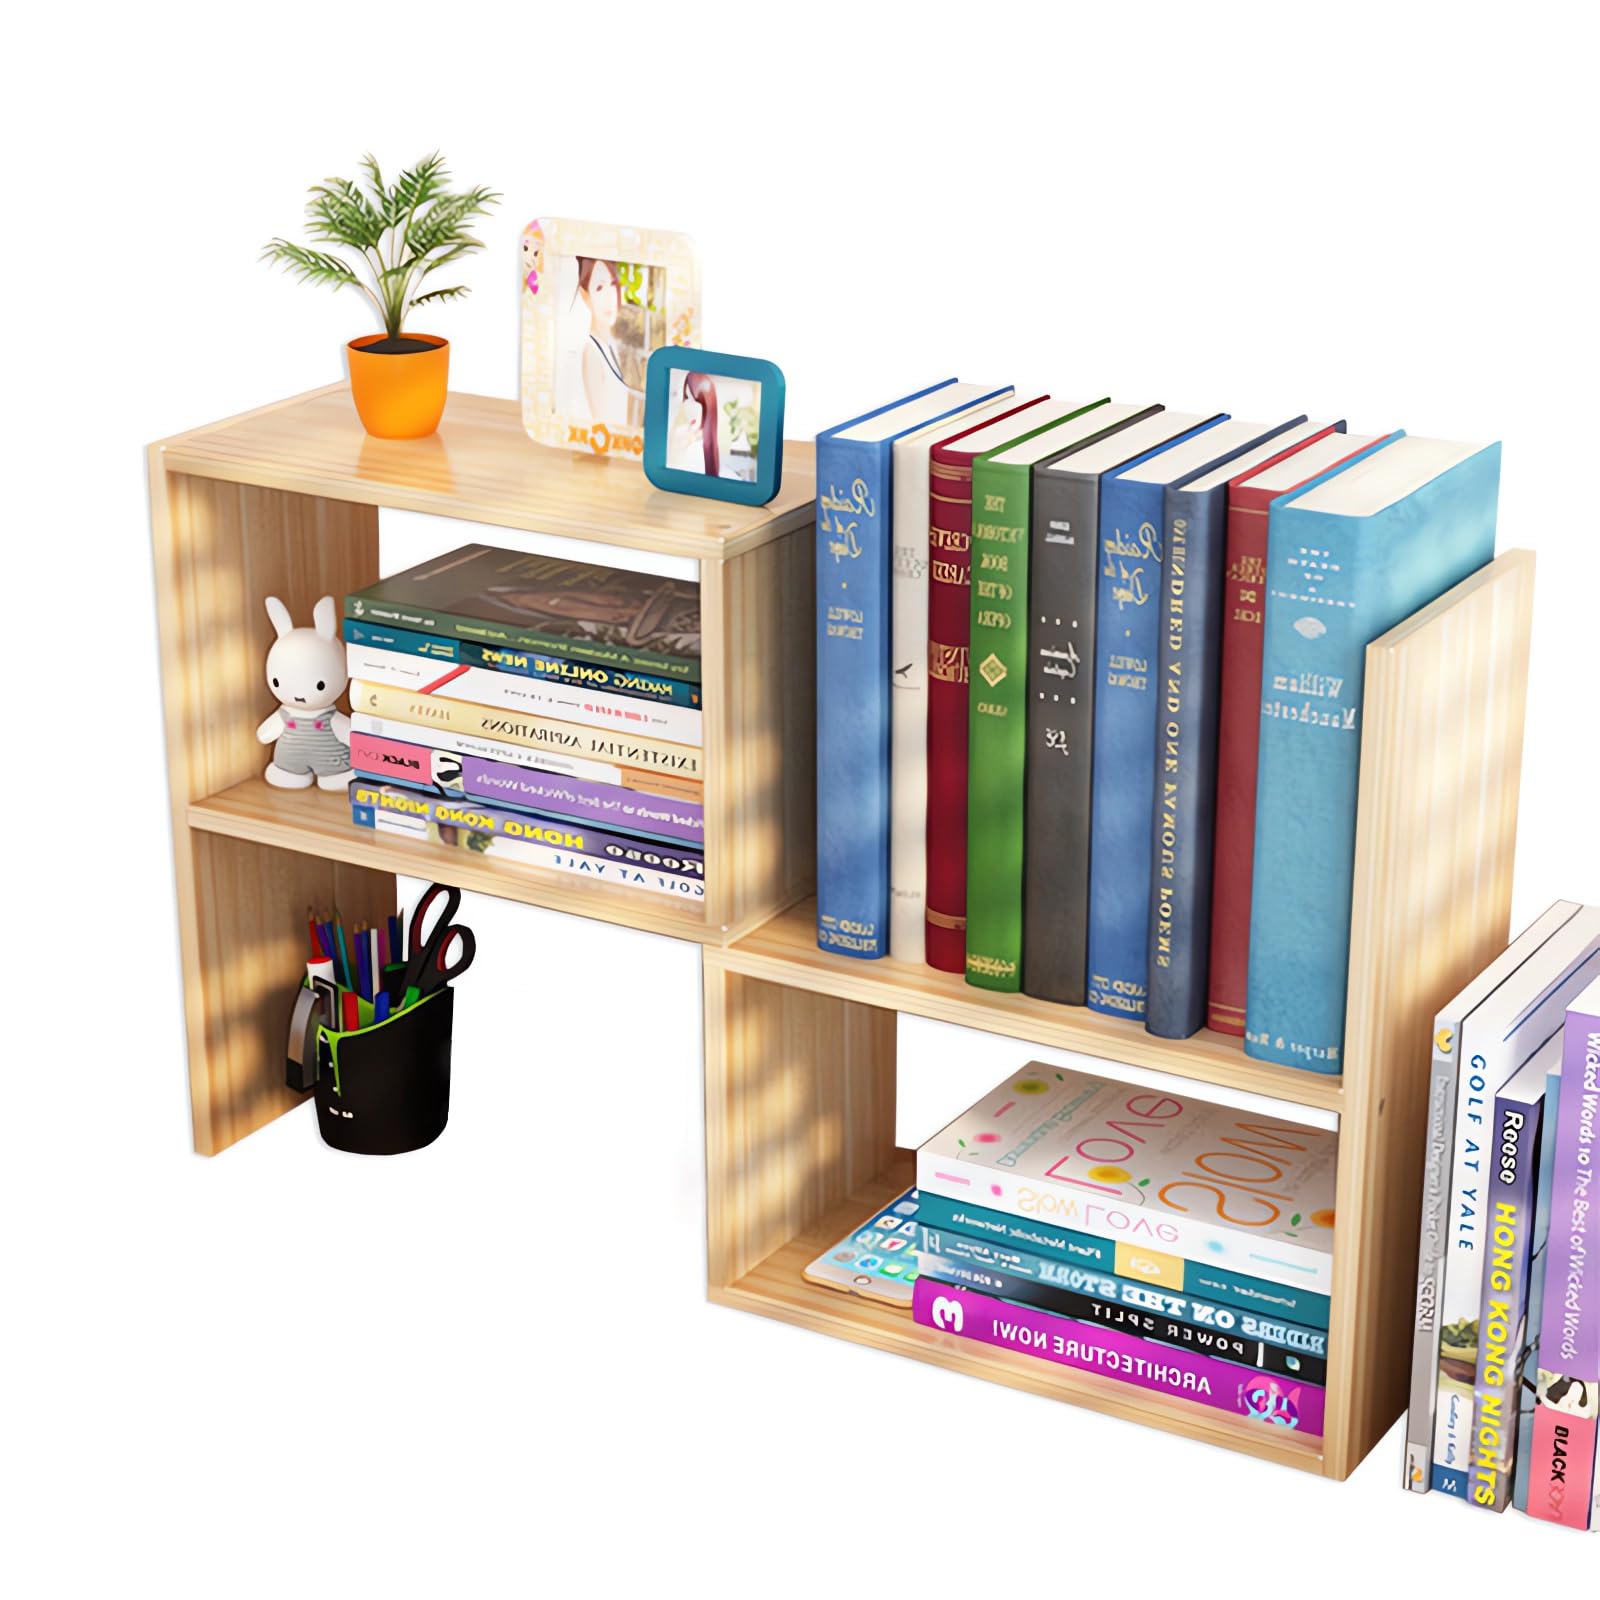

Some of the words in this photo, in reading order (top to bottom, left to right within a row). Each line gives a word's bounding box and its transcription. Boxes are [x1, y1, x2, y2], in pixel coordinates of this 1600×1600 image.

[1467, 1055, 1486, 1125] GOLF
[1578, 1094, 1598, 1143] Words
[1463, 1139, 1480, 1172] AT
[1574, 1169, 1592, 1198] The
[1458, 1188, 1477, 1251] YALE
[1571, 1198, 1590, 1235] Best
[1491, 1201, 1517, 1292] HONG
[1483, 1299, 1509, 1388] KONG
[1560, 1313, 1580, 1361] Words
[1473, 1393, 1503, 1507] NIGHTS
